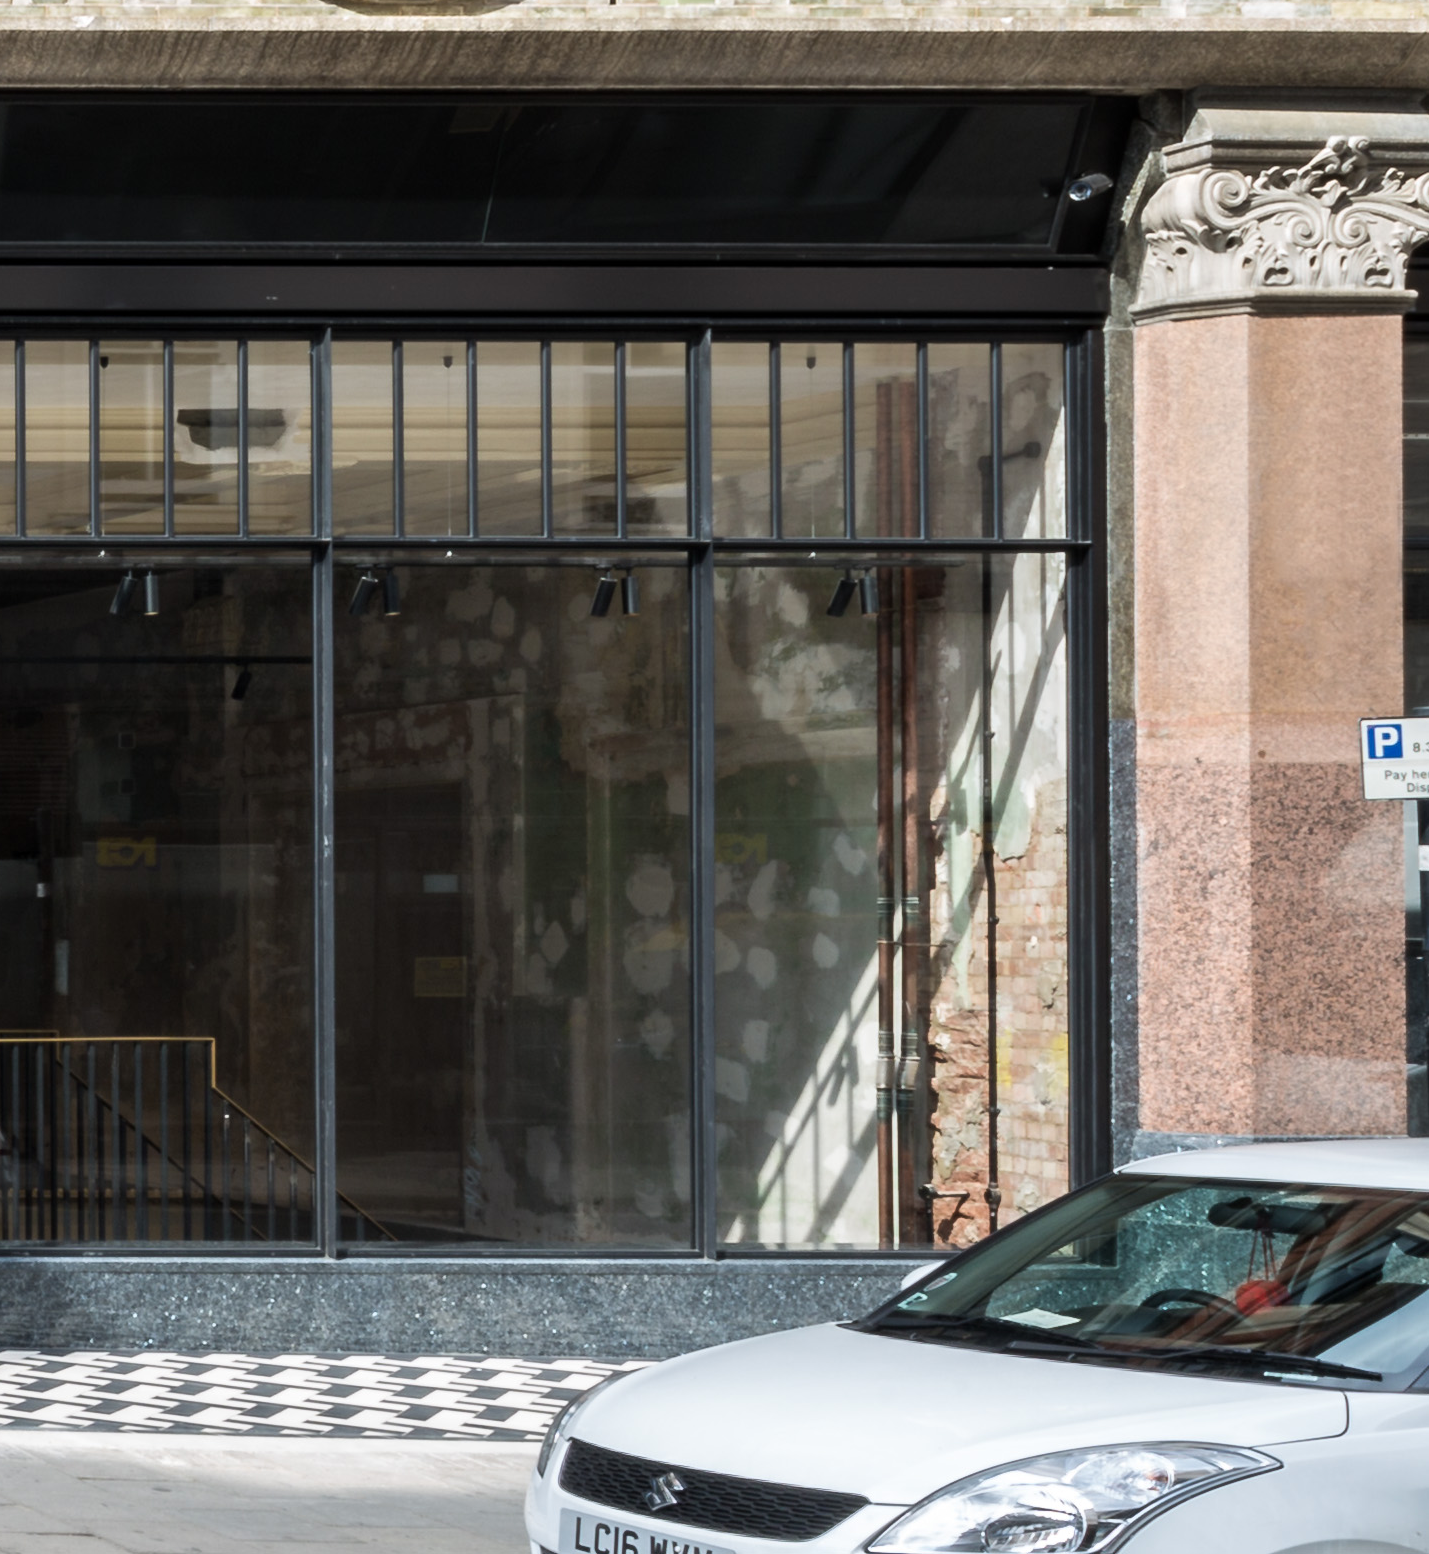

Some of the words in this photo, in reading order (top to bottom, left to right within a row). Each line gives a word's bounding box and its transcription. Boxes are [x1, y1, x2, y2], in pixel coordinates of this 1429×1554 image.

[1374, 727, 1399, 757] P
[1384, 769, 1407, 782] Pay
[1412, 768, 1429, 780] he
[574, 1516, 640, 1554] LC16
